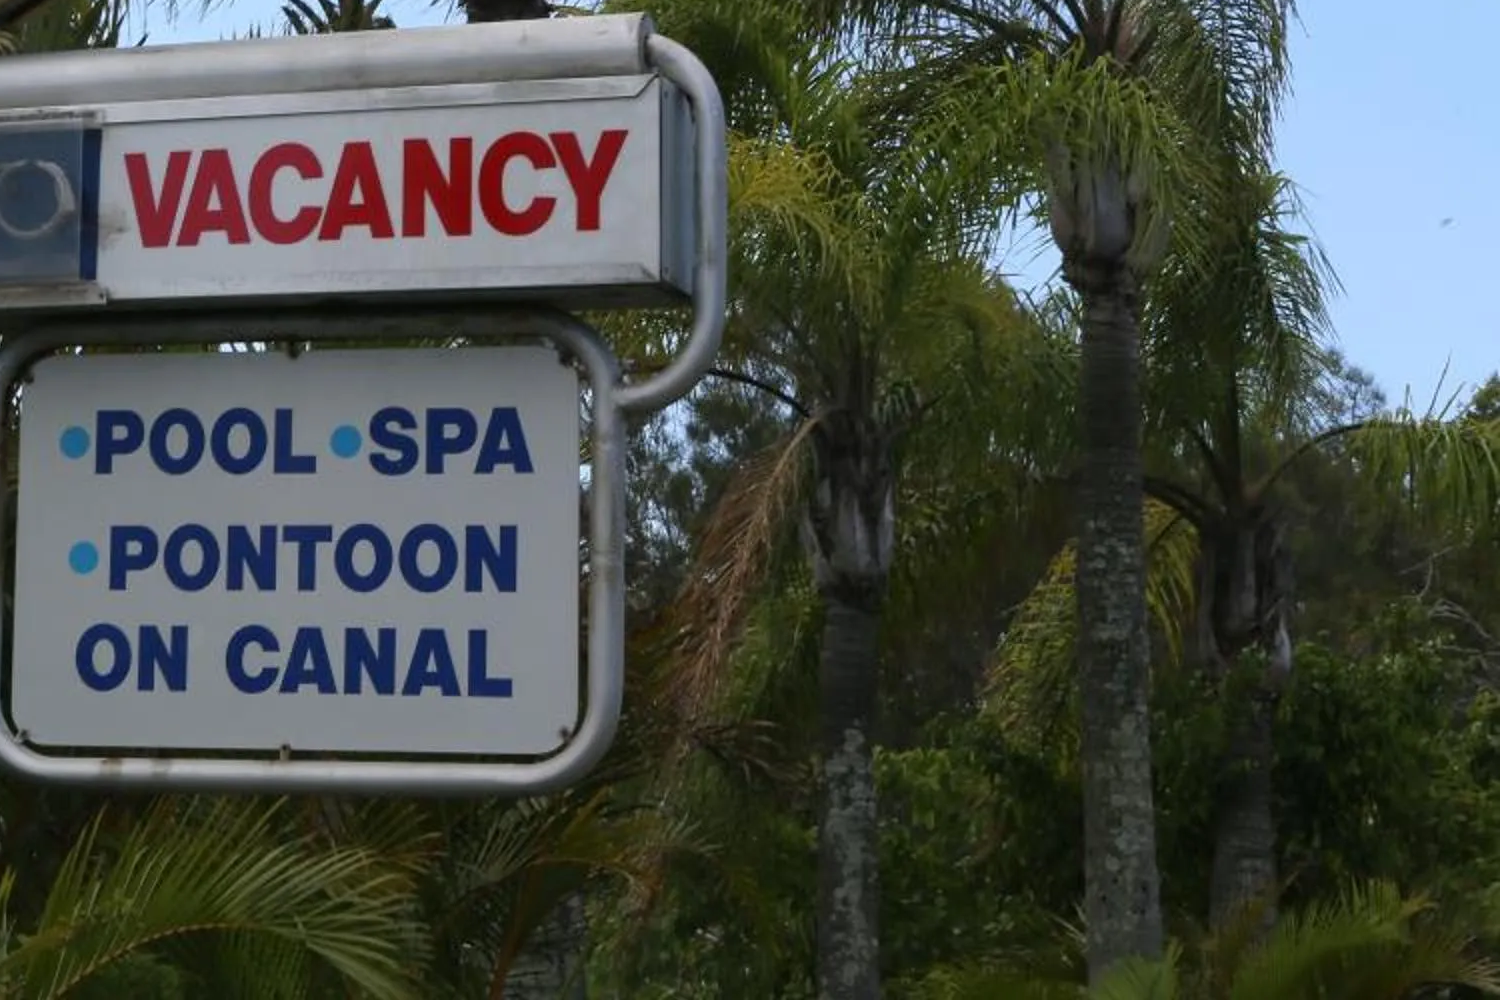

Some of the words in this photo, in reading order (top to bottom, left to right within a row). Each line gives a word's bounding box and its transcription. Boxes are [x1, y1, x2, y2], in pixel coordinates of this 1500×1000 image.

[124, 129, 629, 249] VACANCY
[95, 407, 317, 475] POOL
[368, 406, 534, 475] SPA
[108, 523, 518, 593] PONTOON
[75, 623, 188, 693] ON
[225, 625, 513, 698] CANAL
